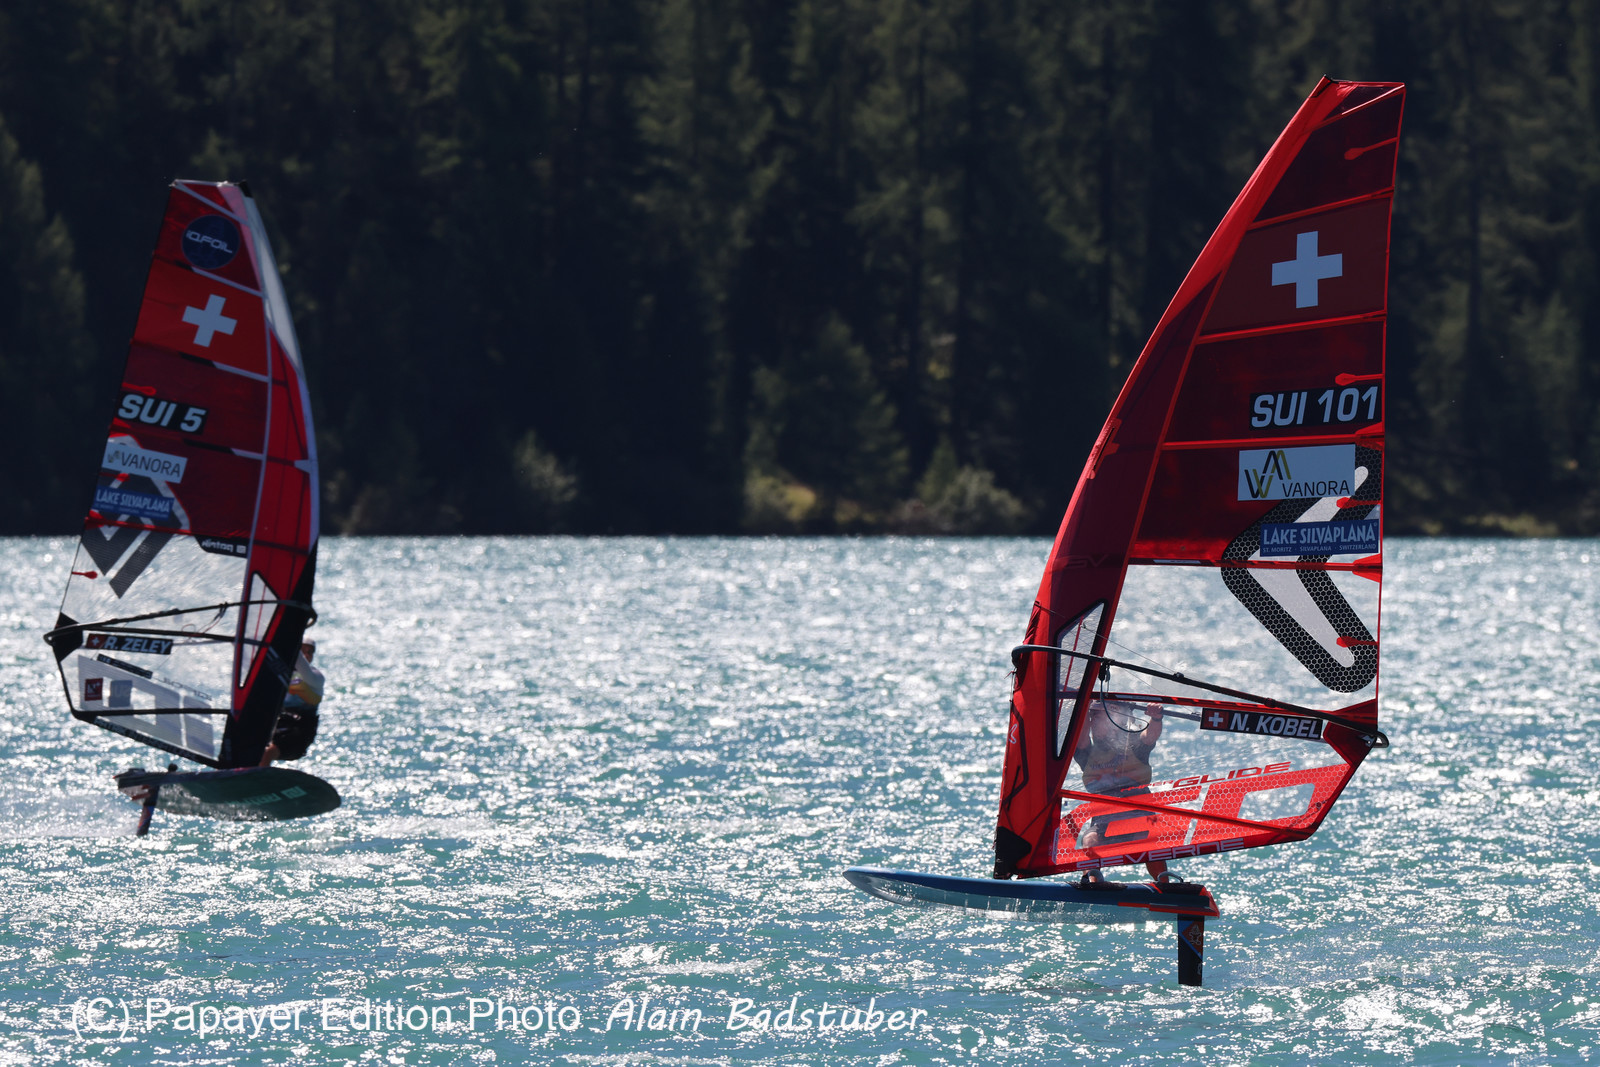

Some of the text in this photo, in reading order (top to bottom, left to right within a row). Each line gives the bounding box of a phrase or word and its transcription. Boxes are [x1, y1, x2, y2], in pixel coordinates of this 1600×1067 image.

[118, 394, 206, 432] SUI 5
[1251, 386, 1378, 428] SUI 101
[120, 451, 181, 478] VANORA
[96, 489, 120, 504] LAKE
[1282, 480, 1350, 498] VANORA
[1263, 522, 1376, 546] LAKE SILVAPLANA
[104, 636, 172, 654] R. ZELEY
[1229, 713, 1319, 739] N. KOBEL
[1173, 761, 1291, 788] GLIDE
[1076, 838, 1244, 870] SEVERNE
